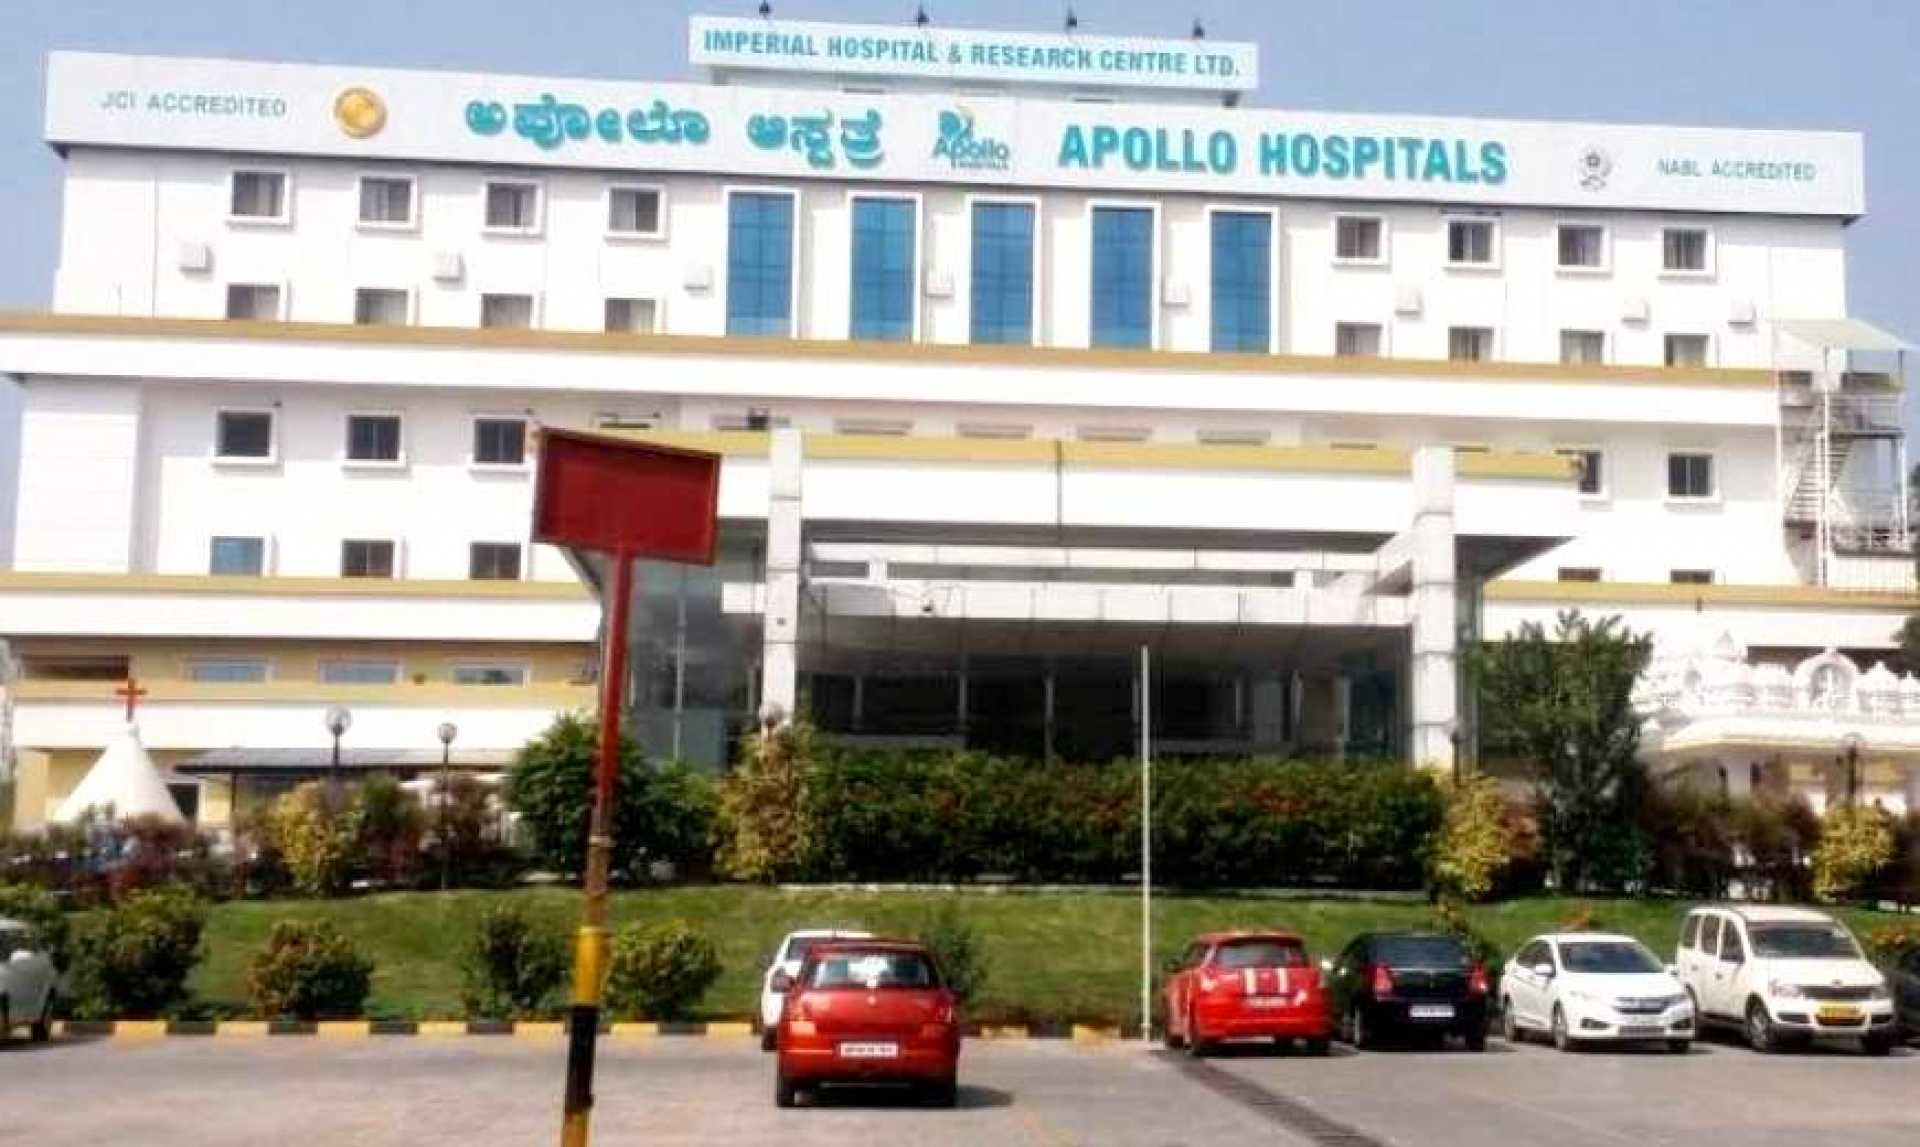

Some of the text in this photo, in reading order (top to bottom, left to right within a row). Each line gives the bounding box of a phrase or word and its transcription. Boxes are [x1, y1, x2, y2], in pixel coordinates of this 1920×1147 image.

[704, 29, 1241, 77] IMPERIAL HOSPITAL & RESEARCH CENTRE LTD.
[101, 90, 287, 118] JCI ACCREDITED
[1057, 124, 1509, 185] APOLLO HOSPITALS
[1711, 158, 1818, 182] ACCREDITED
